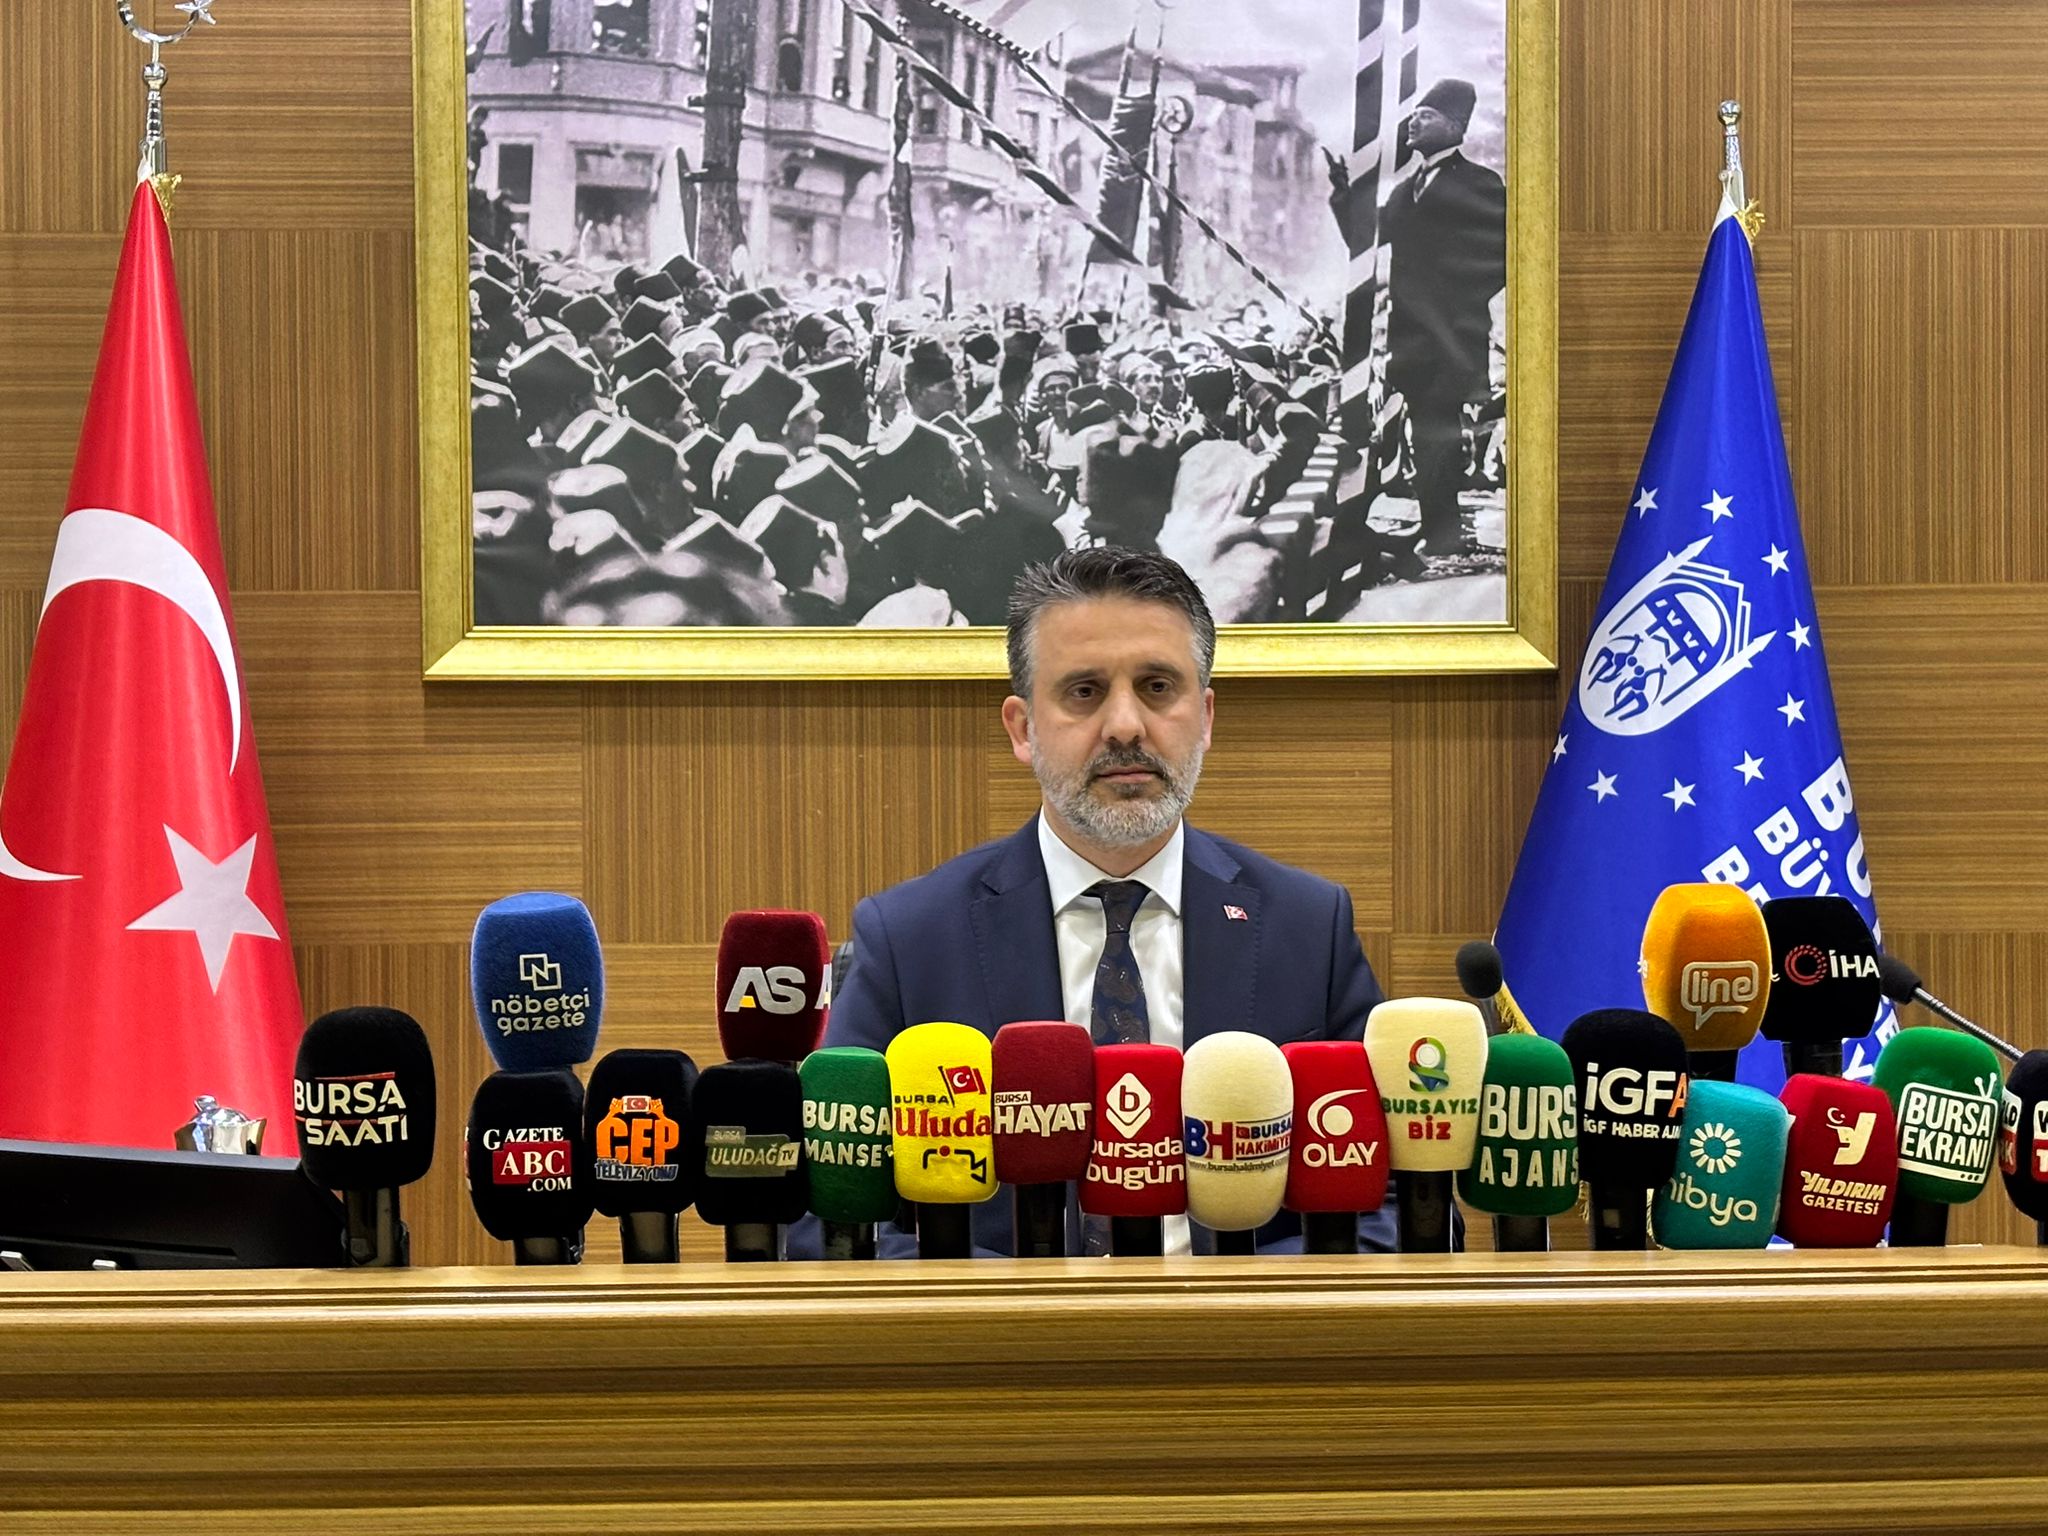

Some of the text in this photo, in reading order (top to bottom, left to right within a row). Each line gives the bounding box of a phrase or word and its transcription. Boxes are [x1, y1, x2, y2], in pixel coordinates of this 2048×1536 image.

[724, 966, 806, 1015] AS
[1691, 970, 1753, 1003] line
[491, 987, 590, 1014] nöbetçi
[497, 1011, 585, 1037] gazete
[294, 1079, 407, 1114] BURSA
[894, 1094, 949, 1105] BURSA
[994, 1093, 1029, 1104] BURSA
[1381, 1097, 1478, 1114] BURSAYIZ
[803, 1100, 892, 1136] BURSA
[993, 1102, 1093, 1137] HAYAT
[1905, 1090, 1991, 1138] BURSA
[483, 1127, 565, 1150] GAZETE
[1184, 1115, 1234, 1160] BH
[1612, 1121, 1660, 1138] HABER
[711, 1143, 795, 1166] ULUDAĞ TV
[1302, 1141, 1378, 1167] OLAY
[1901, 1124, 1989, 1169] EKRANI
[500, 1150, 566, 1175] ABC
[527, 1177, 573, 1192] .COM
[1800, 1170, 1887, 1201] YILDIRIM
